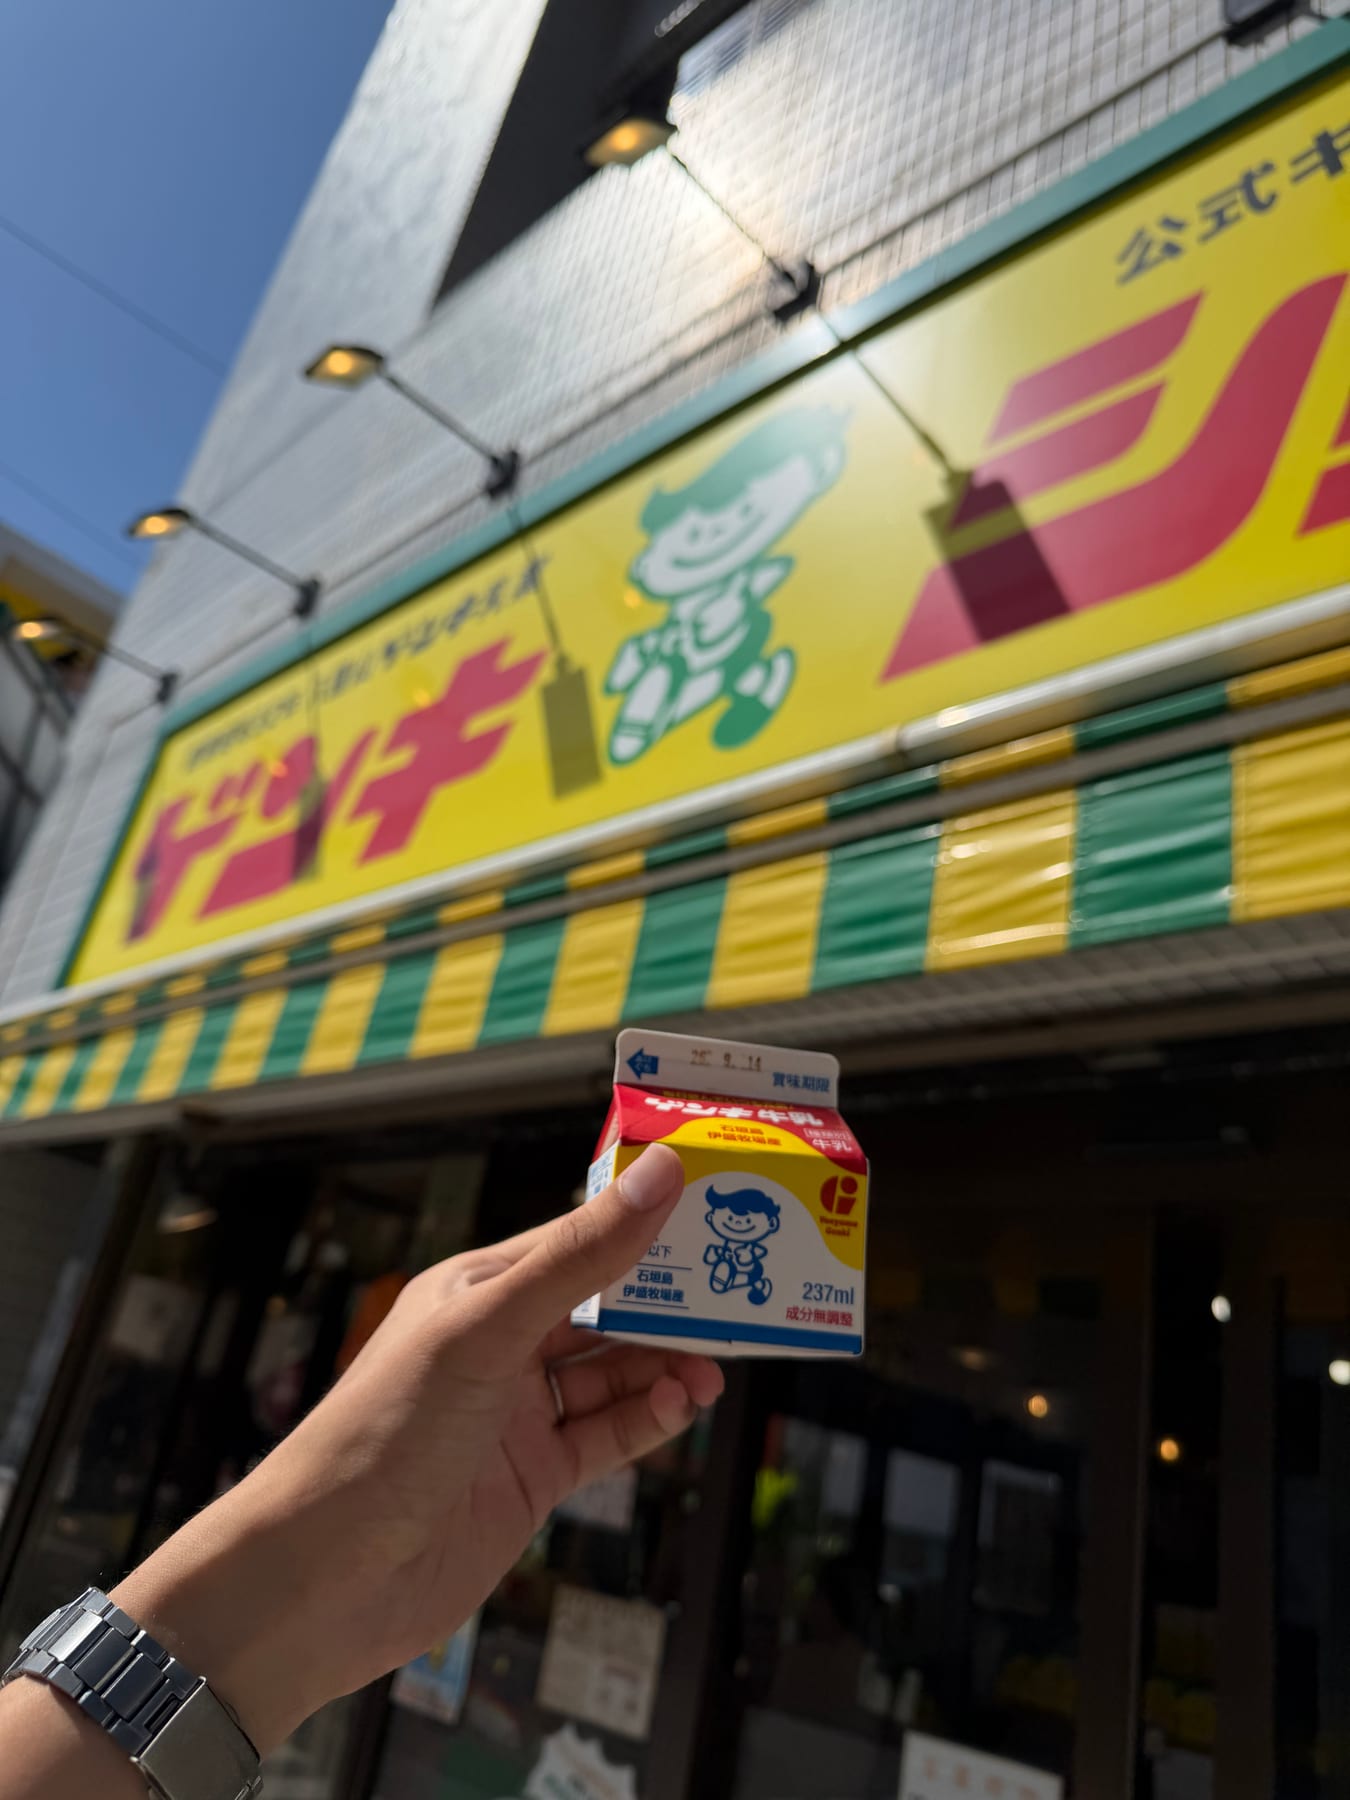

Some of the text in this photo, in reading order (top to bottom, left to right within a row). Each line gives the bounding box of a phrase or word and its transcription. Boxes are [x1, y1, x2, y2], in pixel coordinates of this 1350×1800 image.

[772, 1071, 830, 1093] 賞味期限
[812, 1138, 852, 1152] 牛乳
[637, 1268, 673, 1285] 石垣島
[623, 1283, 685, 1303] 伊盛牧場産
[802, 1281, 855, 1305] 237ml
[785, 1305, 853, 1328] 成分無調整
